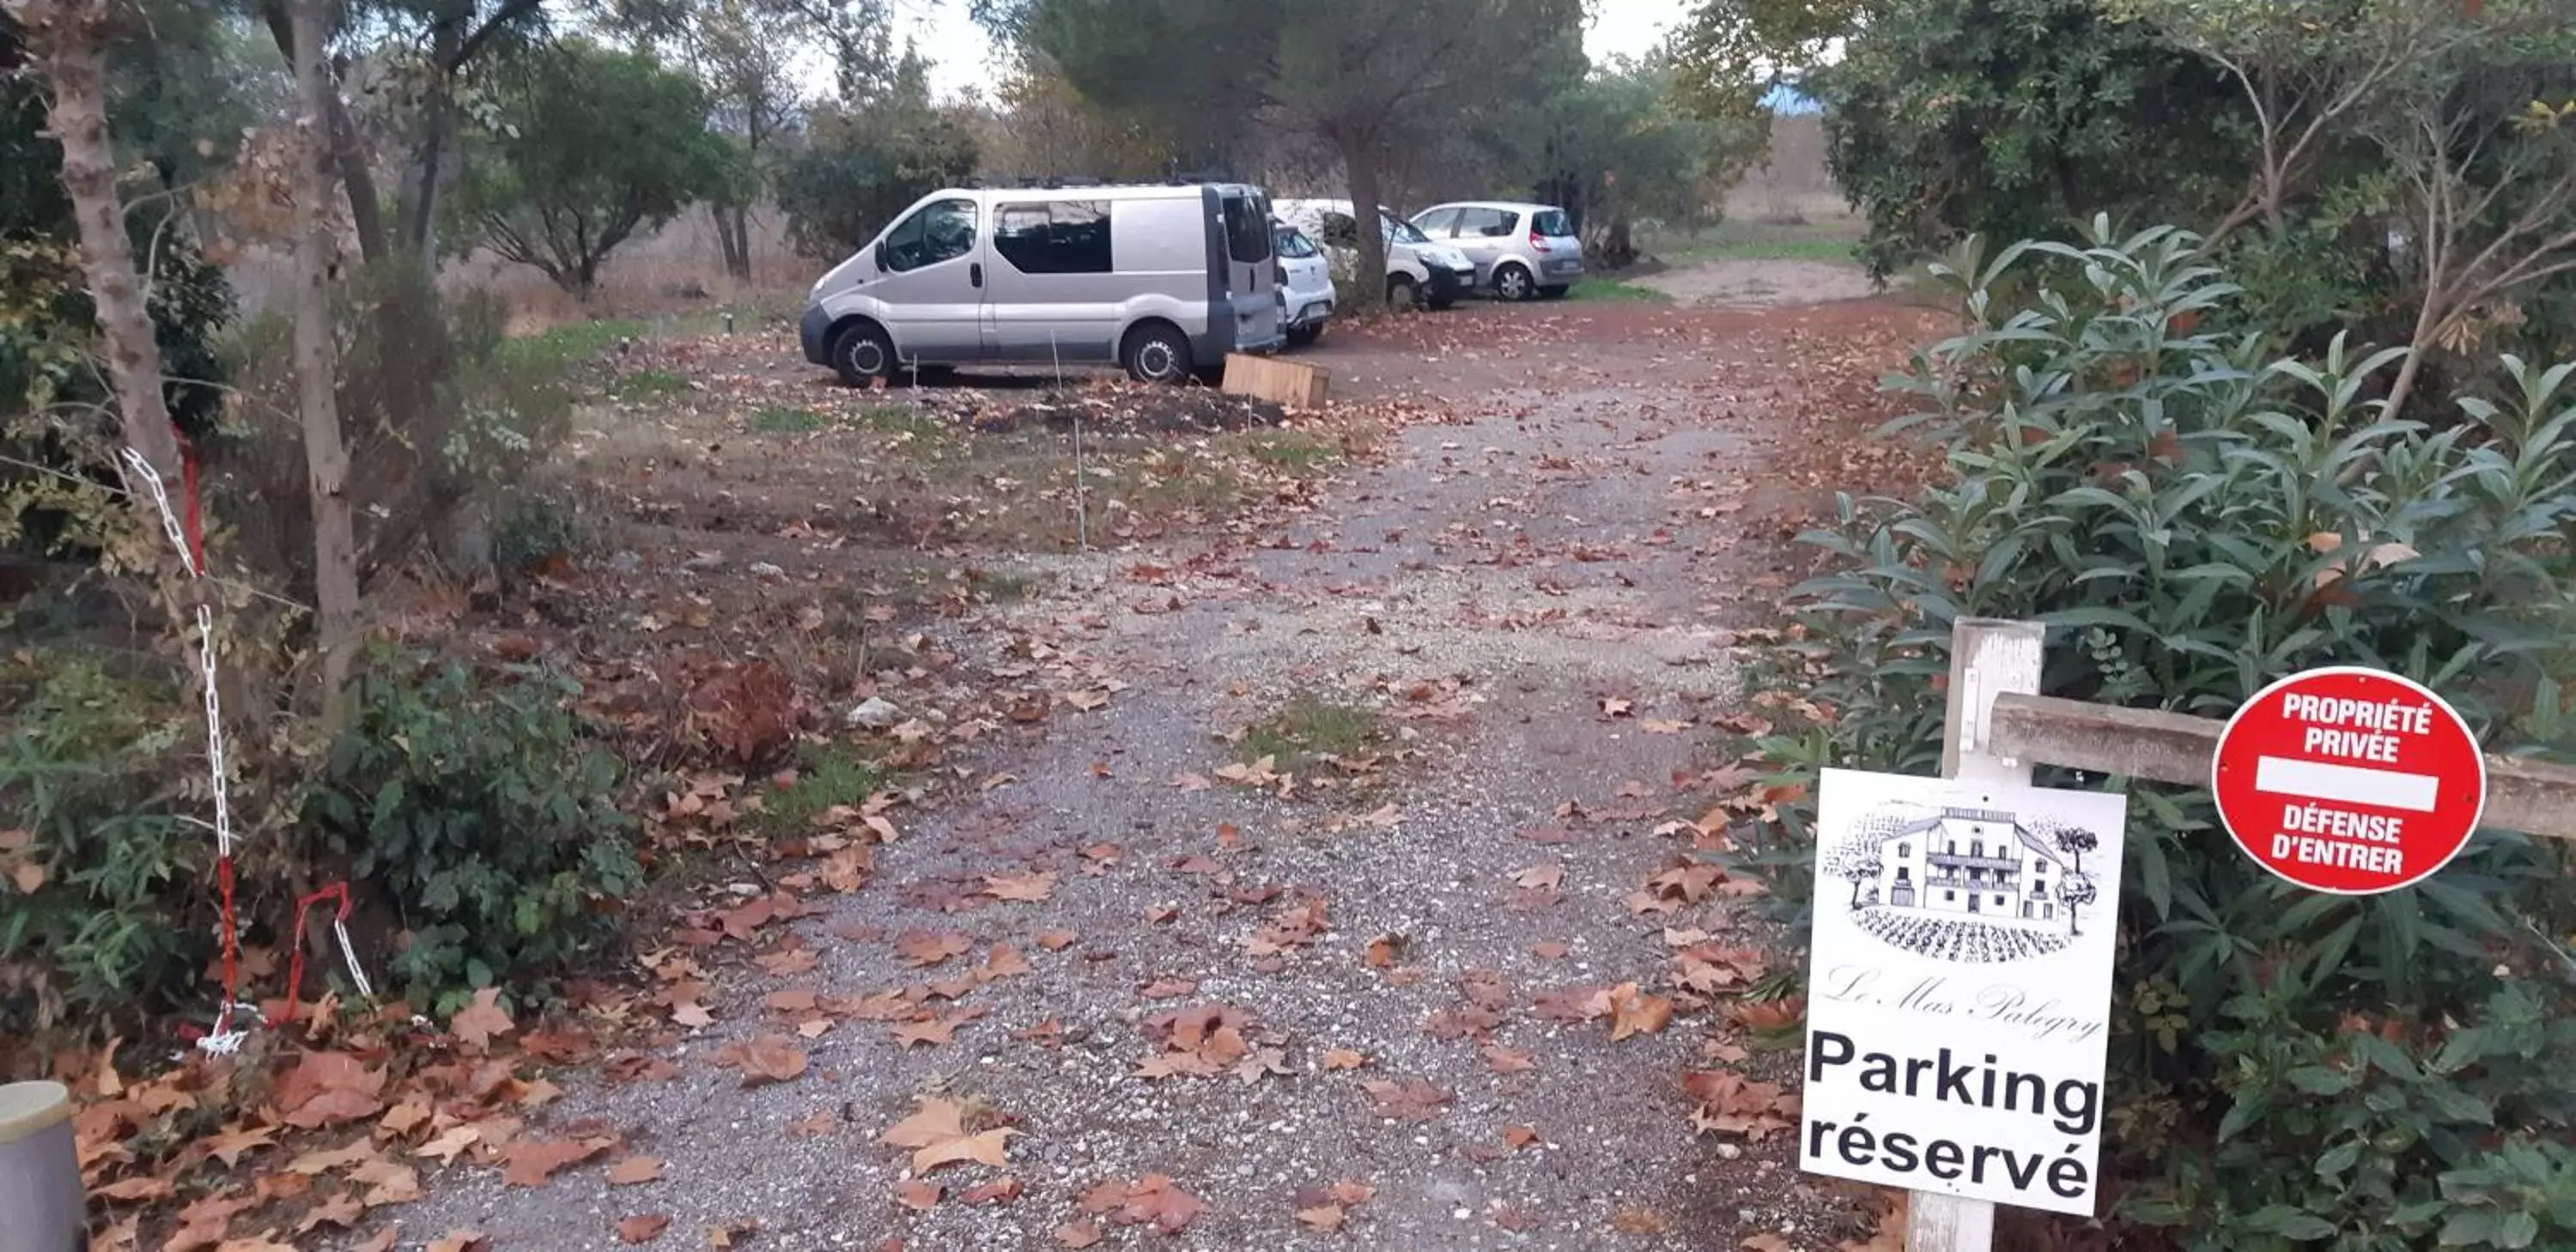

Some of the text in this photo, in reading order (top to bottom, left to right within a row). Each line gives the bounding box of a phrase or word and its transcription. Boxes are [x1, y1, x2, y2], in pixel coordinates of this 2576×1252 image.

[2282, 692, 2433, 734] PROPRIÉTÉ
[2304, 726, 2400, 763] PRIVÉE
[2283, 801, 2403, 843] DÉFENSE
[2271, 833, 2403, 874] D'ENTRER
[1815, 963, 2103, 1043] Le Mas Palegry
[1809, 1030, 2098, 1136] Parking
[1808, 1112, 2089, 1198] réservé
